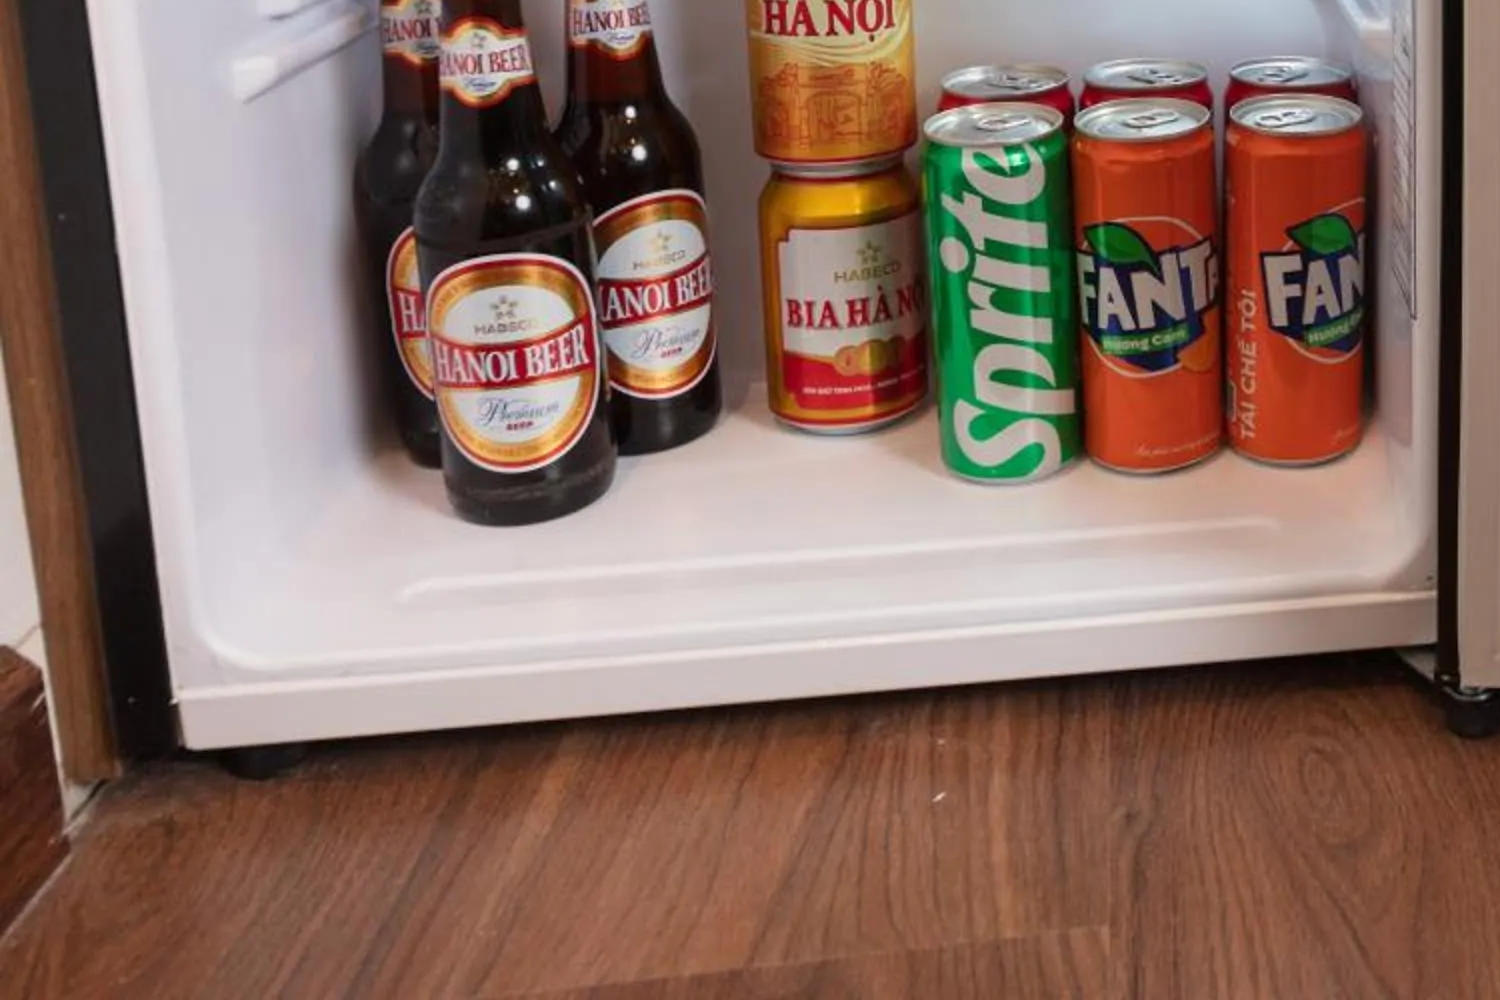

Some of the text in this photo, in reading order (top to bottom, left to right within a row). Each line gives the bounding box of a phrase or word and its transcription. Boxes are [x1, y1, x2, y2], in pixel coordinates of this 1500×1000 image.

[786, 298, 839, 328] BIA
[846, 284, 892, 328] HÀ
[938, 144, 1077, 480] Sprite
[434, 324, 590, 383] HANOI BEER
